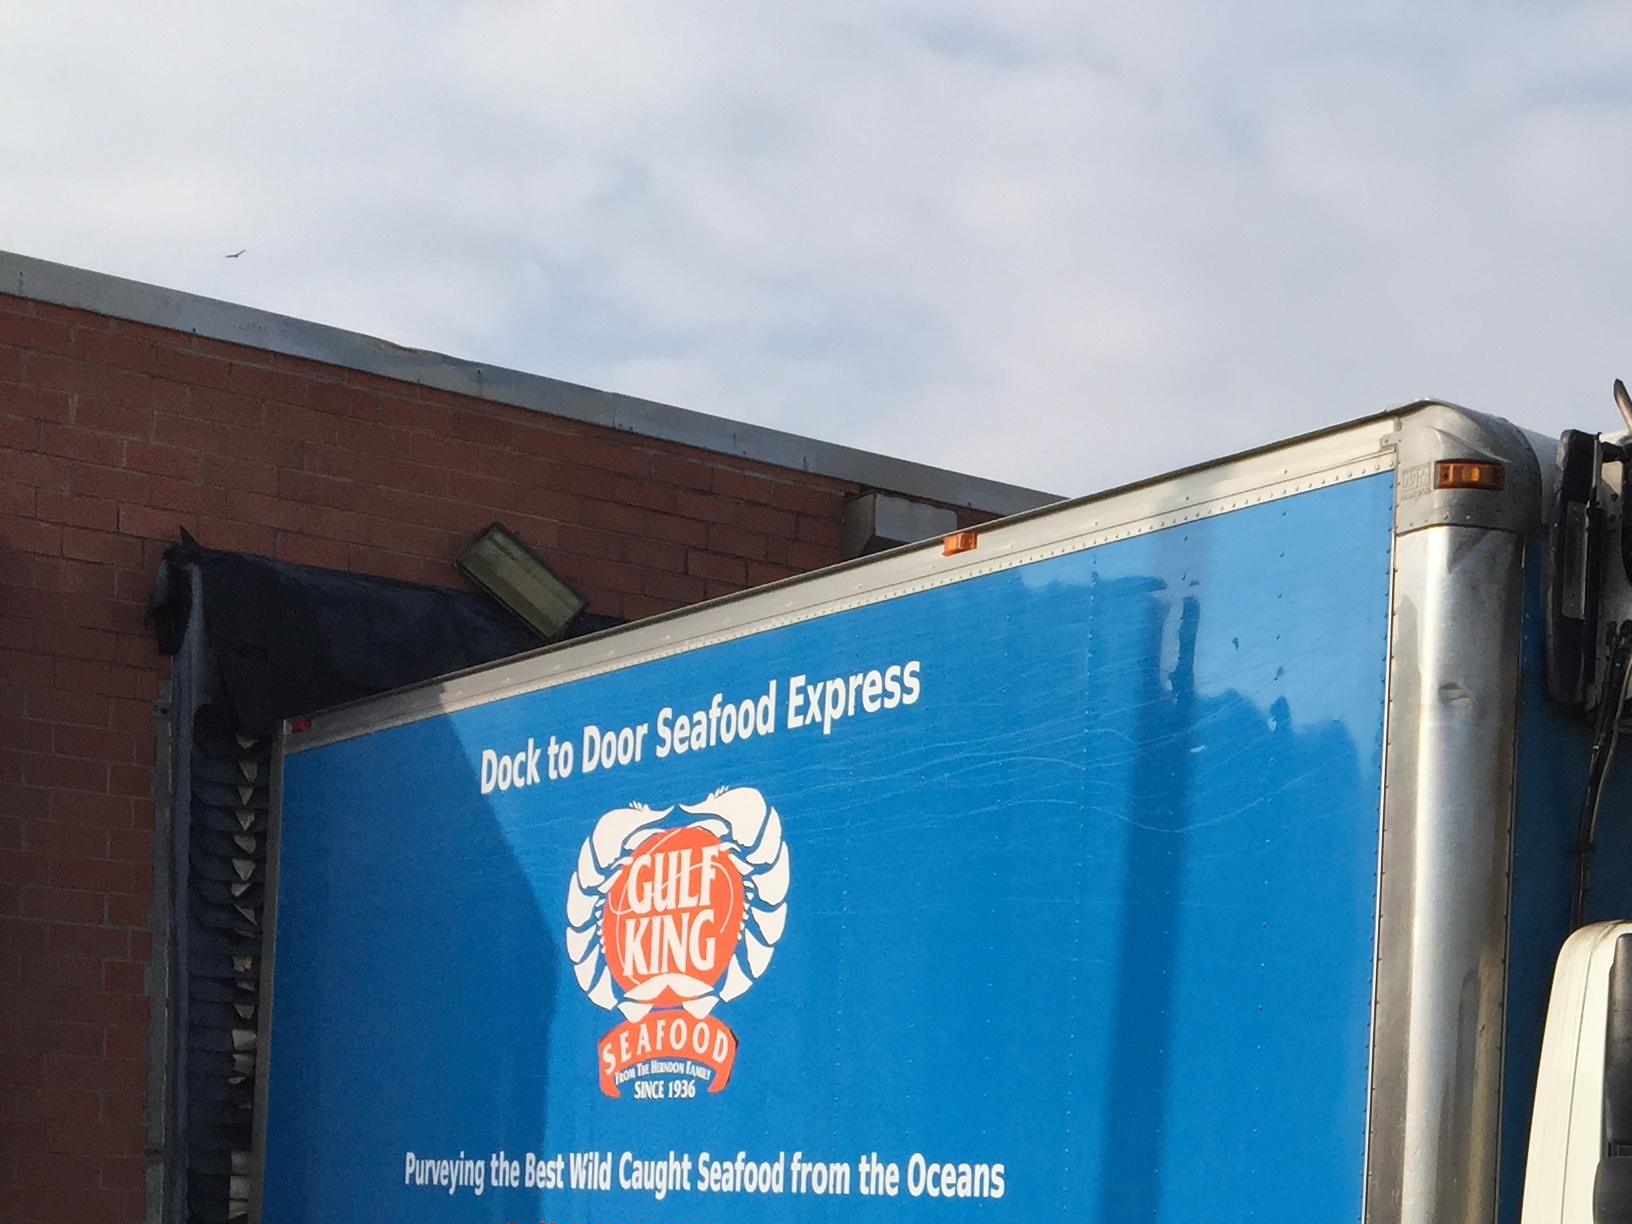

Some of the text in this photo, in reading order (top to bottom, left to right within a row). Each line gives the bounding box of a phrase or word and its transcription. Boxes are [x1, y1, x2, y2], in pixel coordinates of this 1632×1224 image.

[481, 660, 921, 794] Dock to Door Seafood Express
[627, 846, 719, 914] GULF
[623, 909, 716, 977] KING
[602, 1018, 729, 1075] SEAFOOD
[634, 1080, 696, 1099] SINCE 1936
[405, 1151, 1005, 1200] Purveying the Best Wild Caught Seafood from the Oceans
